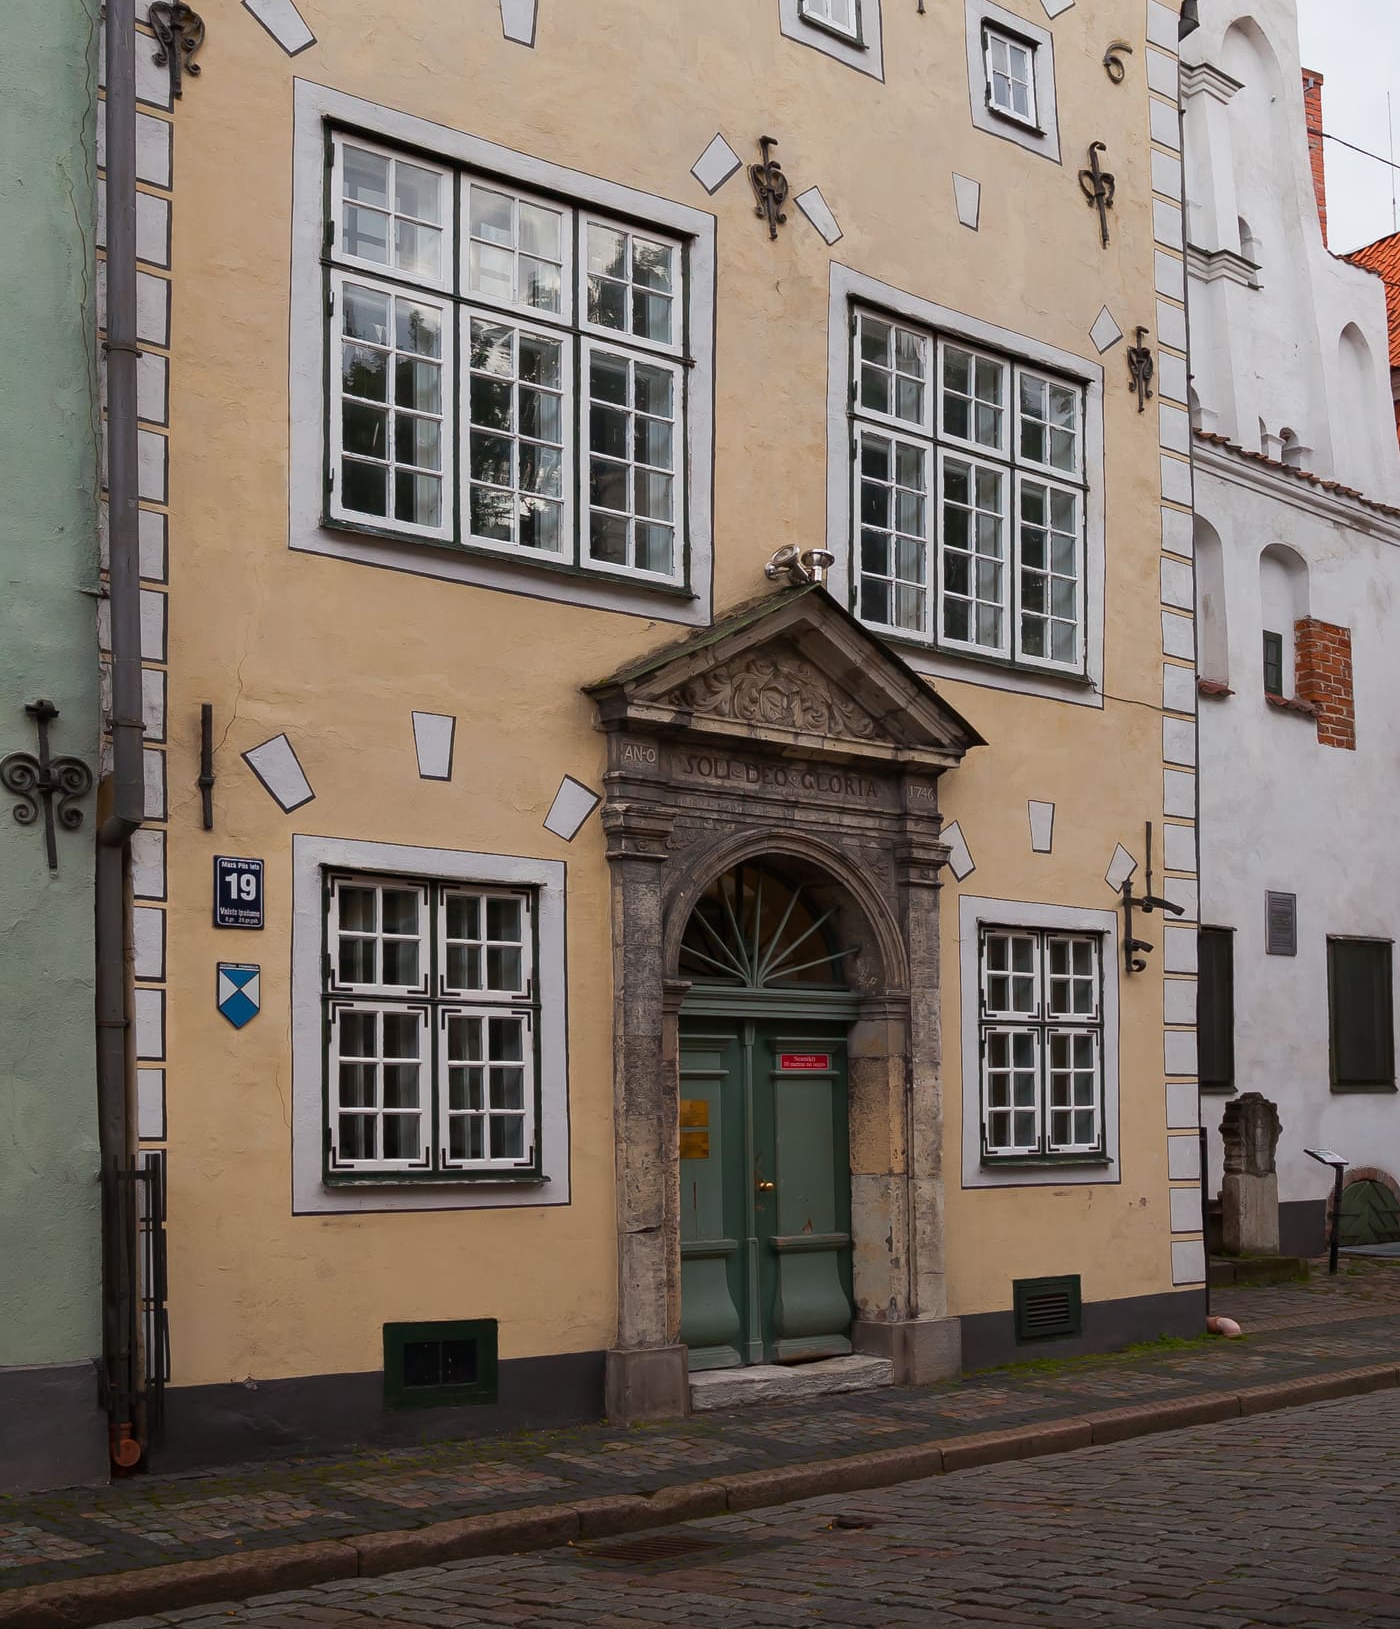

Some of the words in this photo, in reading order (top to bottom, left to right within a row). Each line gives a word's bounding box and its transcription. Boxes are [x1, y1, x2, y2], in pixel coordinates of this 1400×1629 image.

[1103, 42, 1134, 85] 6
[683, 755, 731, 780] SOLI
[744, 763, 788, 787] DEO
[801, 771, 878, 798] GLORIA
[225, 872, 257, 901] 19
